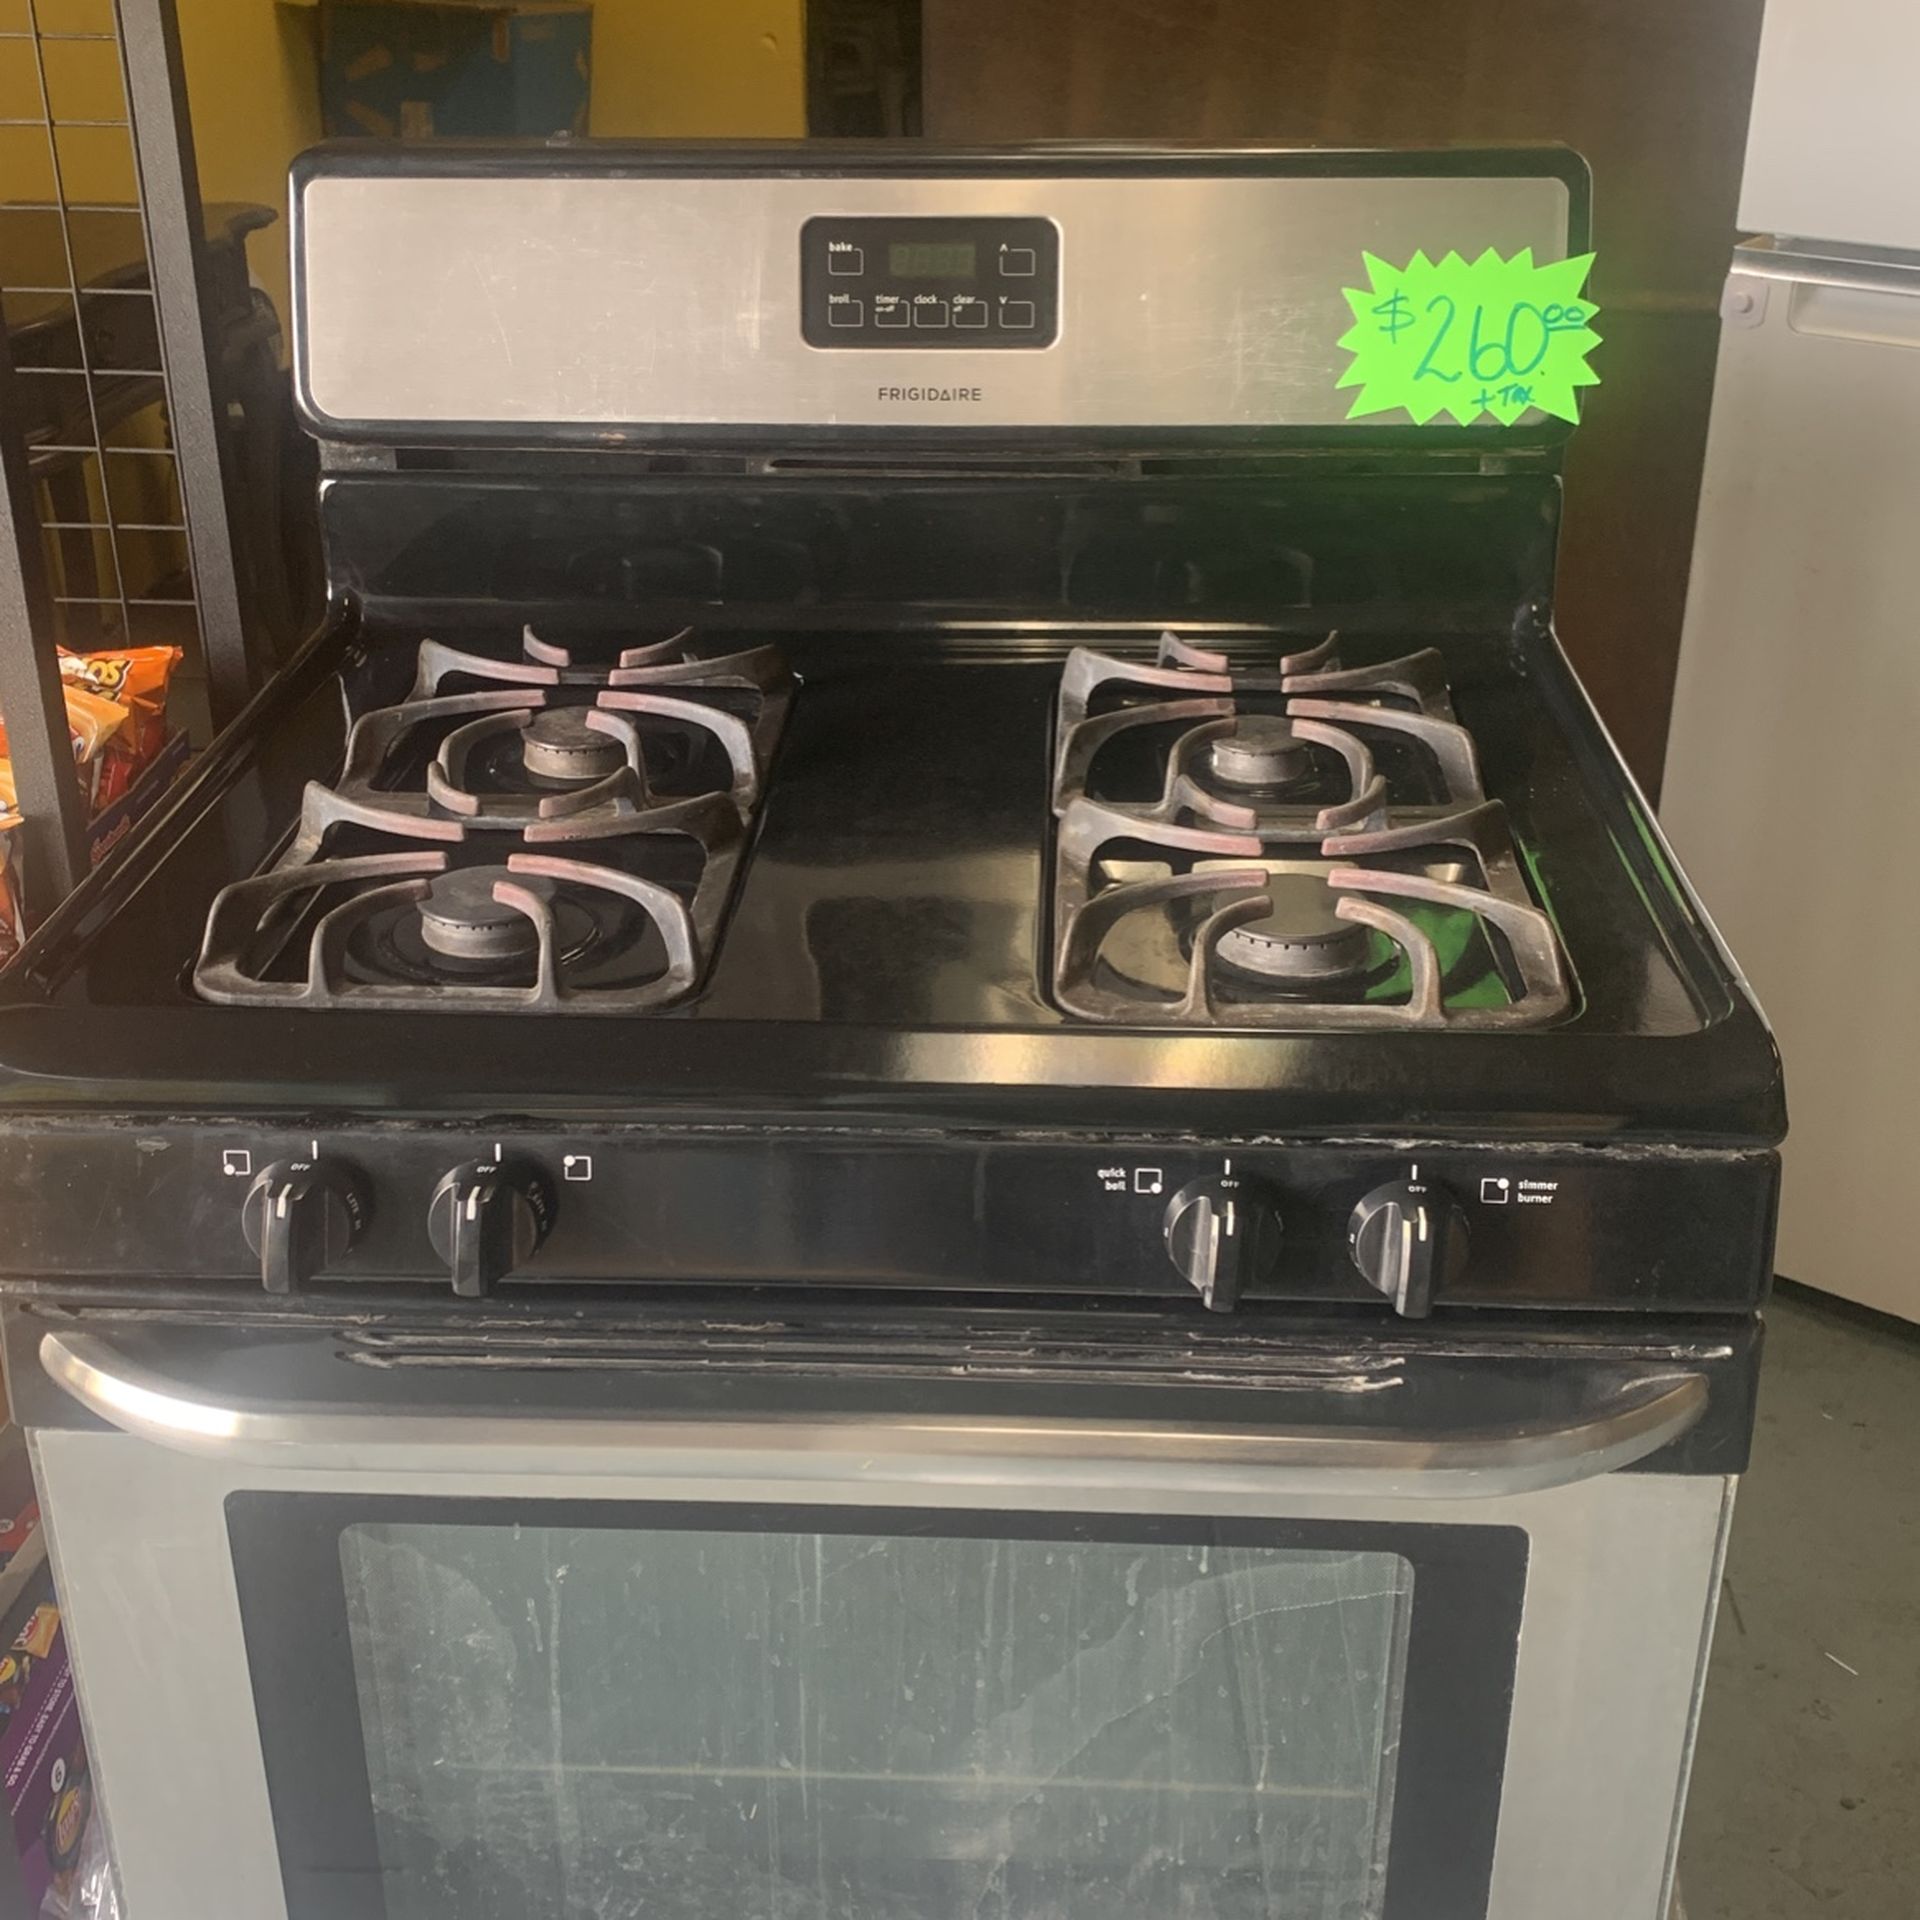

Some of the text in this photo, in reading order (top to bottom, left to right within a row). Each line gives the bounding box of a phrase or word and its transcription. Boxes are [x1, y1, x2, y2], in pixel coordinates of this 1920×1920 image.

[828, 241, 853, 252] bake
[828, 294, 850, 304] broil
[875, 295, 900, 304] timer
[914, 294, 938, 304] clock
[953, 294, 976, 304] clear
[877, 387, 982, 402] FRIGIDAIRE
[290, 1163, 311, 1172] OFF
[476, 1165, 497, 1174] OFF
[1097, 1167, 1127, 1179] quick
[1104, 1180, 1127, 1192] boil
[1220, 1179, 1240, 1189] OFF
[1407, 1184, 1428, 1194] OFF
[1517, 1179, 1559, 1191] simmer
[1517, 1193, 1554, 1205] burner
